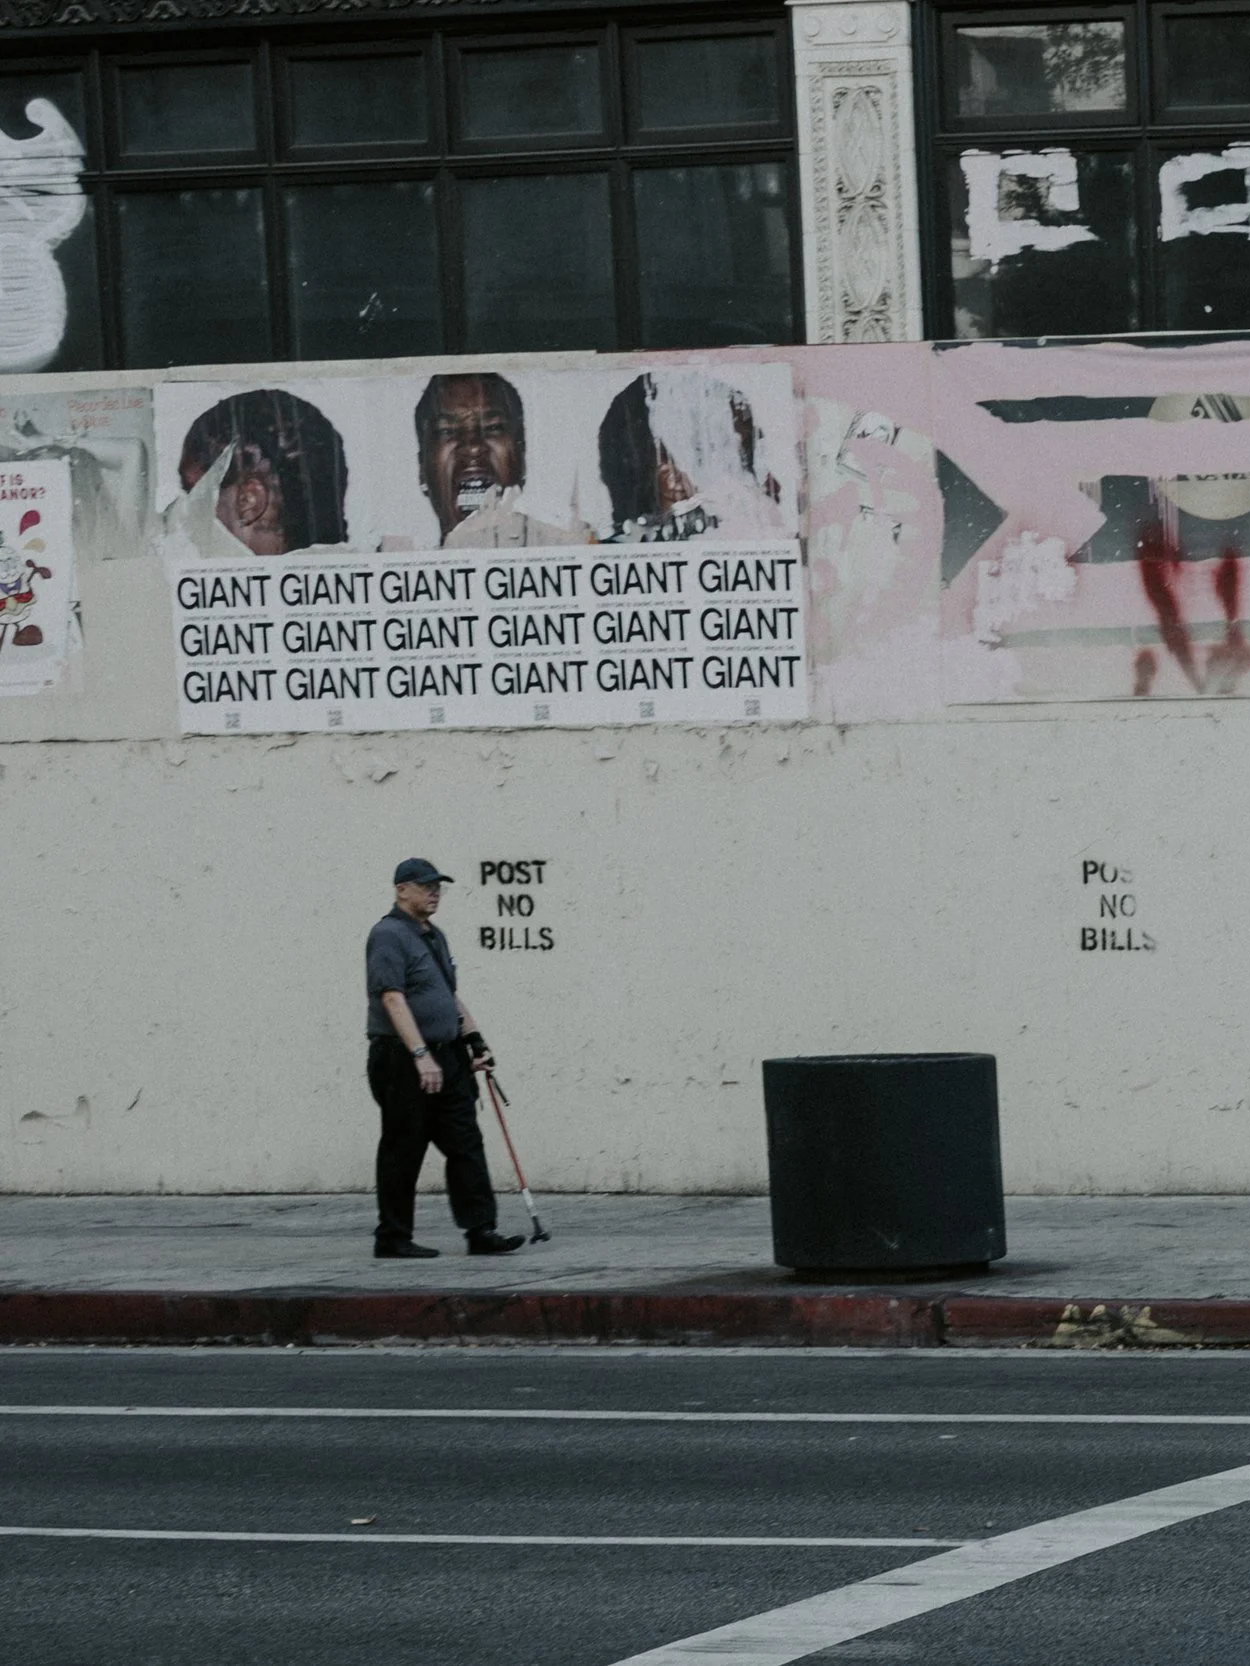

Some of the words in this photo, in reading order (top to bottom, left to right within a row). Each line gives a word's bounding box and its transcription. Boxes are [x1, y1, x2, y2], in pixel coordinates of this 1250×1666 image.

[10, 474, 24, 487] IS
[177, 574, 272, 610] GIANT
[279, 571, 374, 607] GIANT
[379, 567, 476, 604] GIANT
[484, 564, 583, 601] GIANT
[590, 560, 688, 597] GIANT
[698, 558, 797, 593] GIANT
[180, 622, 274, 657] GIANT
[282, 619, 377, 654] GIANT
[383, 615, 479, 652] GIANT
[488, 612, 586, 649] GIANT
[593, 608, 691, 645] GIANT
[700, 607, 799, 642] GIANT
[183, 669, 278, 704] GIANT
[285, 667, 380, 701] GIANT
[386, 663, 483, 699] GIANT
[491, 660, 589, 696] GIANT
[596, 657, 694, 693] GIANT
[702, 655, 801, 689] GIANT
[480, 860, 547, 886] POST
[497, 893, 535, 917] NO
[1100, 893, 1136, 919] NO
[480, 926, 555, 951] BILLS
